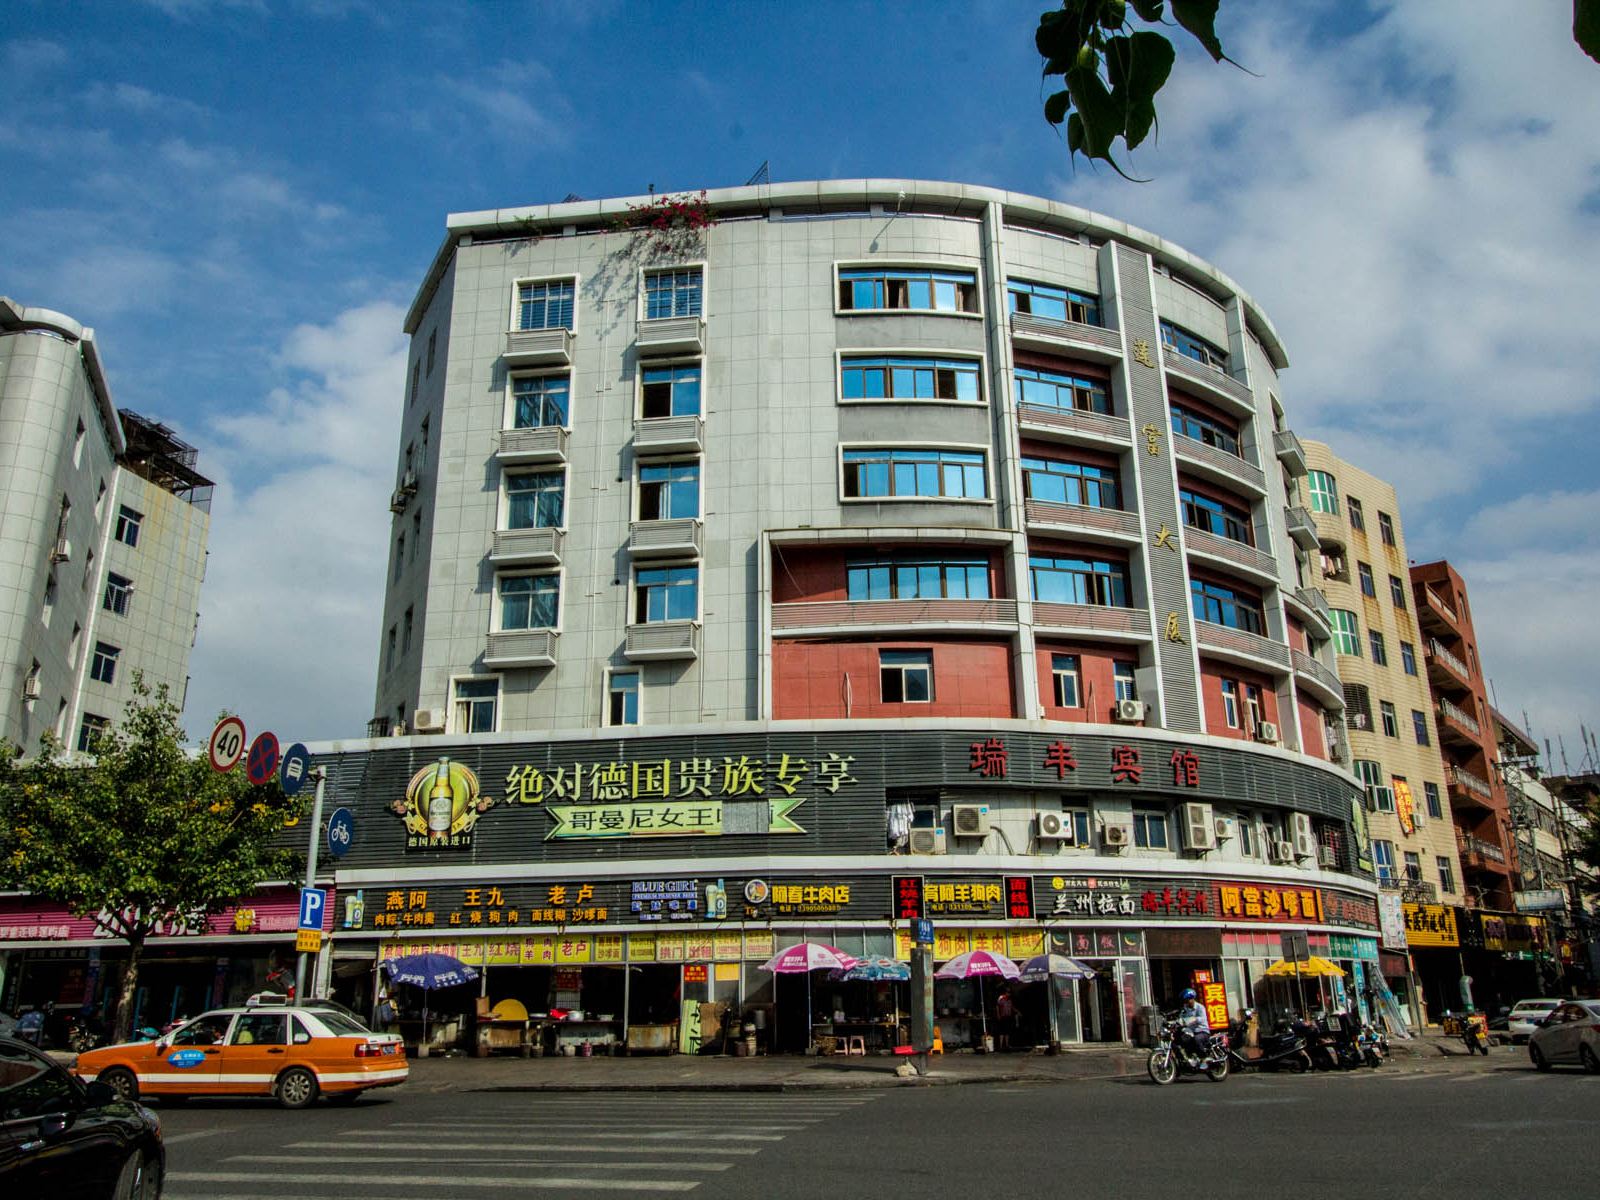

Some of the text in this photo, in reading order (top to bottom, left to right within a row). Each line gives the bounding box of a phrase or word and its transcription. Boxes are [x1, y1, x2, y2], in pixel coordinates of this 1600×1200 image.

[216, 731, 240, 758] 40
[970, 737, 1200, 786] 瑞丰宾馆
[504, 752, 857, 804] 绝对德国贵族专享
[568, 805, 774, 831] 哥曼尼女王
[464, 887, 504, 906] 王九
[549, 884, 594, 905] 老卢
[1053, 891, 1135, 915] 兰州拉面
[303, 893, 320, 925] P
